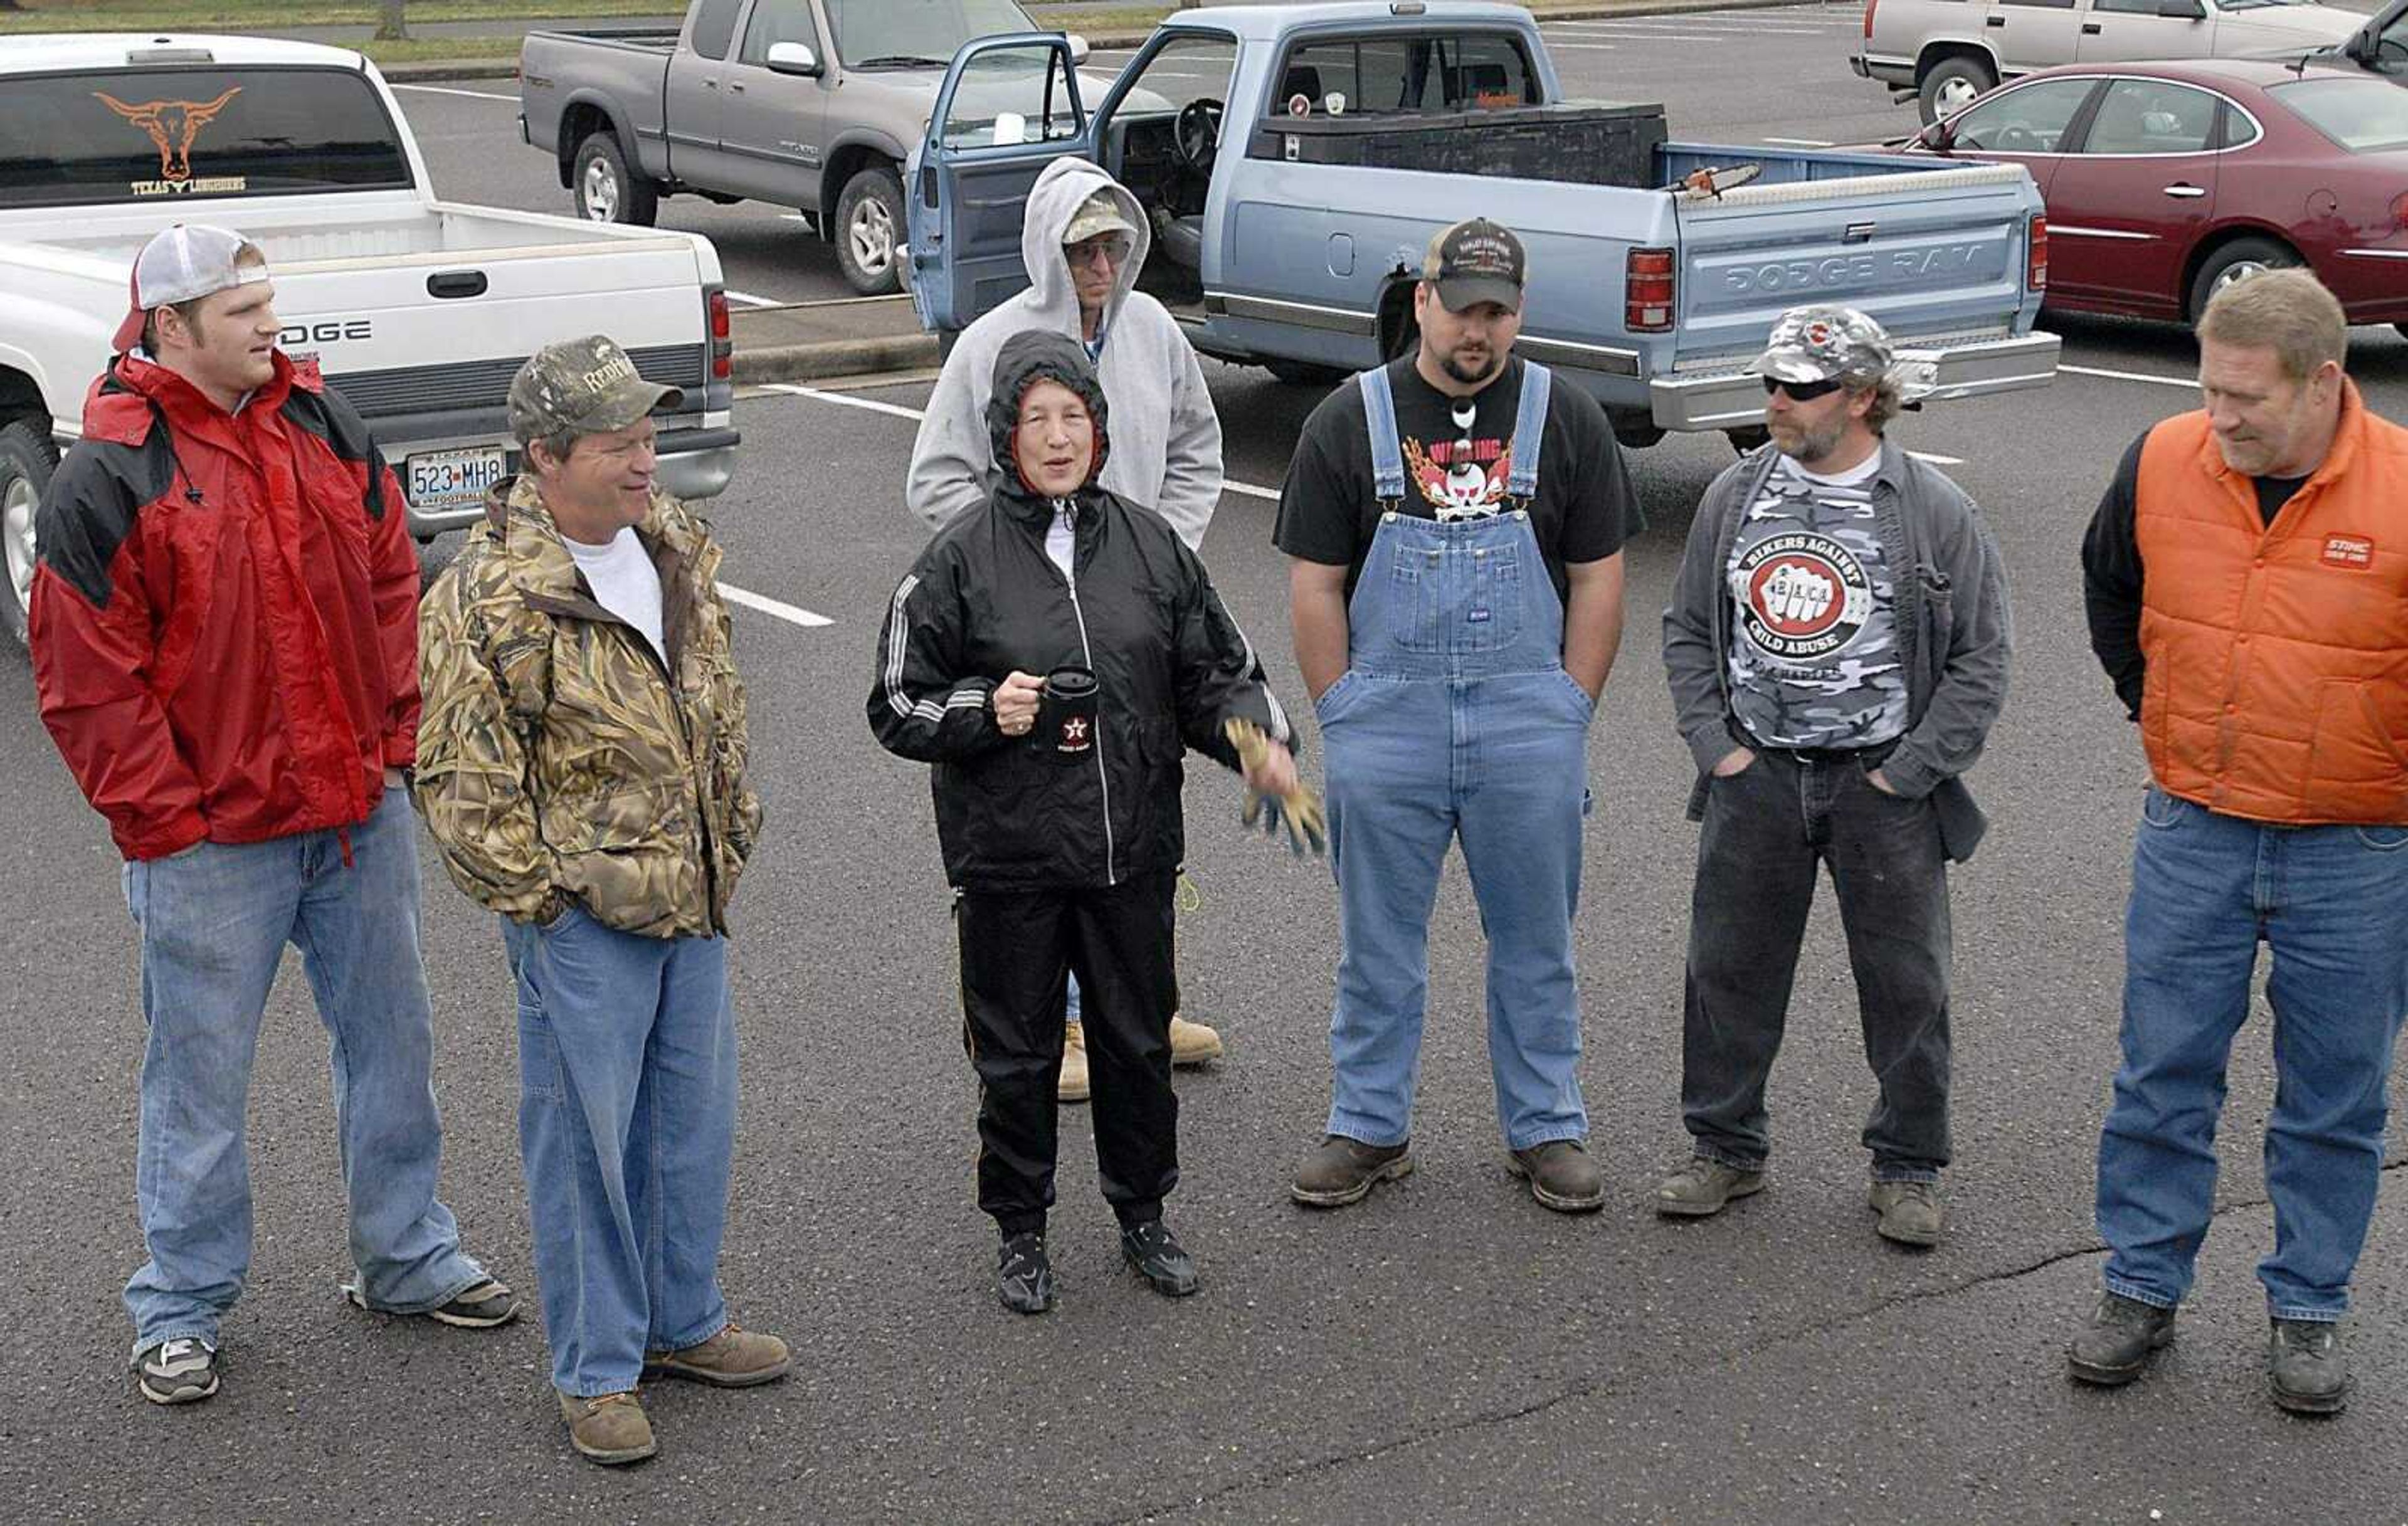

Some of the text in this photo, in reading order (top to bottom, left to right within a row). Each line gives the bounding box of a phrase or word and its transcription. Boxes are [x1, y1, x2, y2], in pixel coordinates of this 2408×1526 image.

[130, 180, 169, 196] TEXAS
[1726, 256, 1875, 292] DODGE
[280, 320, 371, 344] DGE
[1430, 438, 1501, 464] WING
[415, 464, 453, 494] 523
[1746, 536, 1861, 583] BIKERS AGAINST
[1749, 620, 1839, 655] CHILD ABUSE
